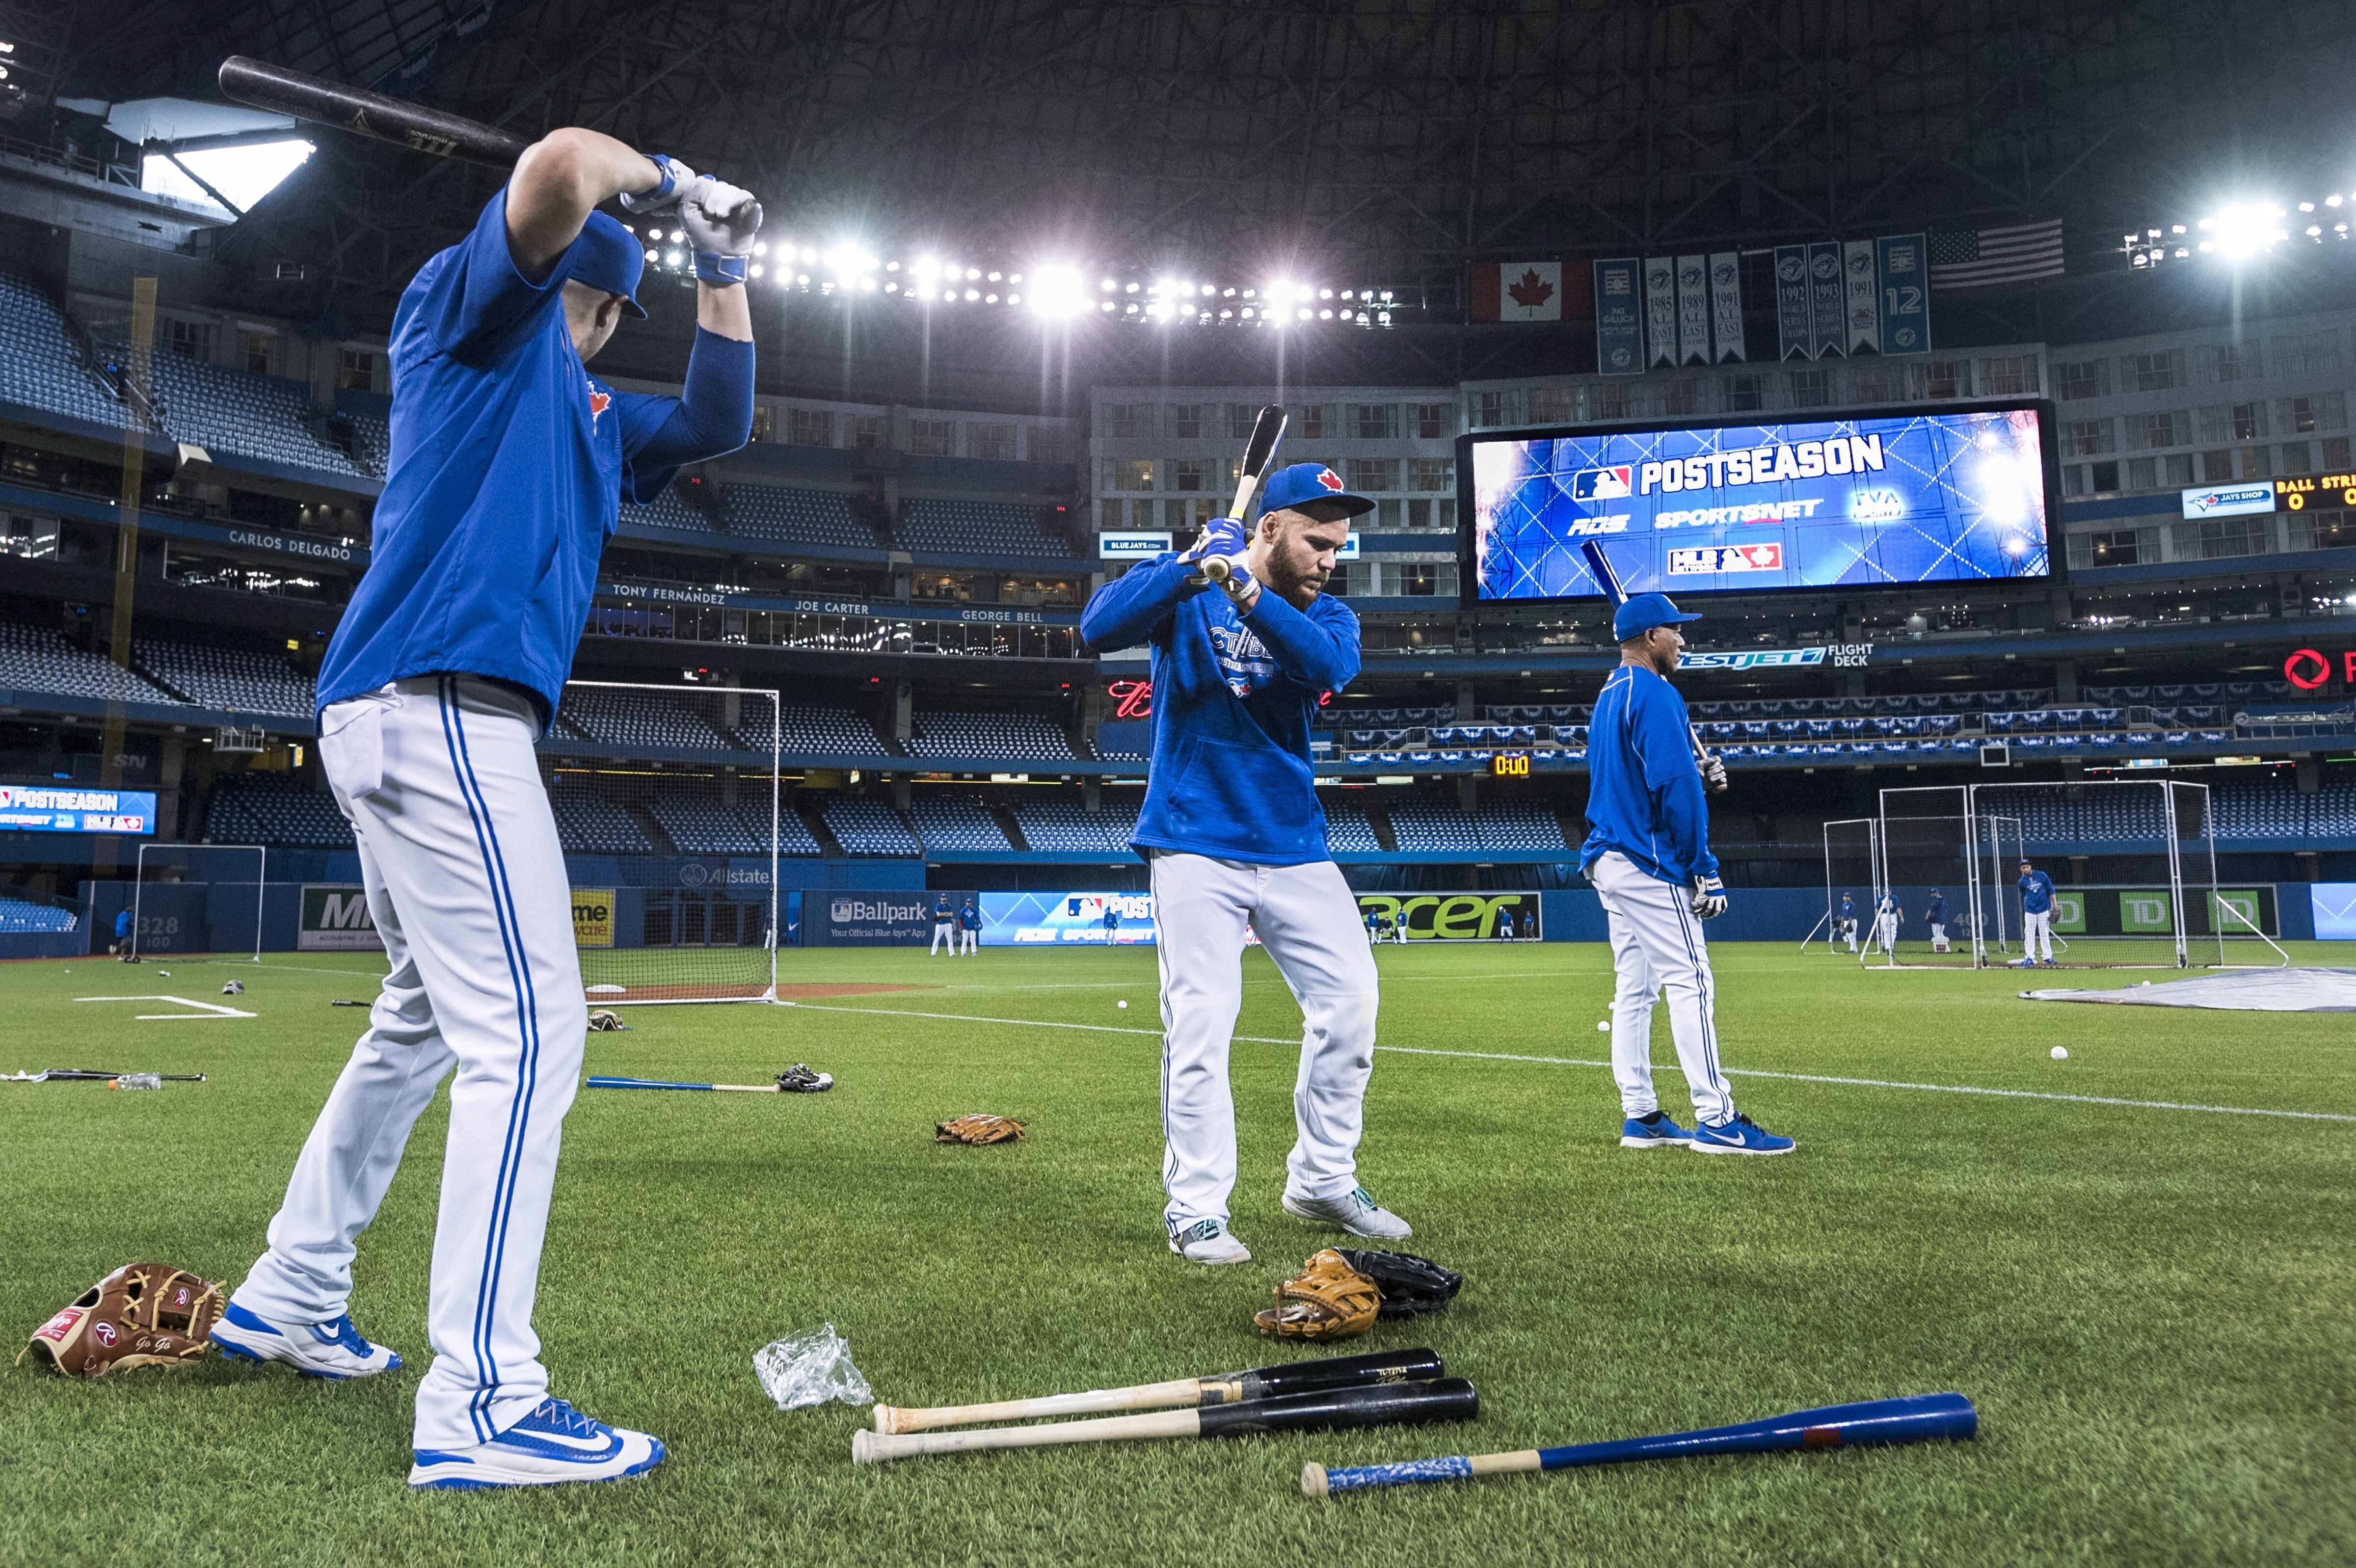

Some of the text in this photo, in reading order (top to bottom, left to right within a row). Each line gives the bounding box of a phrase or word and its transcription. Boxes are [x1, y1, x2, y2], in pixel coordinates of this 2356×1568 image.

[1781, 286, 1805, 302] 1992
[1816, 283, 1839, 300] 1993
[1850, 280, 1873, 296] 1991
[1651, 296, 1673, 312] 1985
[1682, 294, 1705, 310] 1989
[1715, 291, 1738, 307] 1991
[1886, 286, 1921, 315] 12
[1683, 324, 1706, 337] EAST
[1717, 322, 1740, 334] EAST
[1639, 433, 1885, 496] POSTSEASON
[2276, 478, 2315, 494] BALL
[2221, 491, 2263, 502] JAYS SHOP
[2288, 493, 2304, 510] 0
[1654, 499, 1820, 529] SPORTSNET
[1567, 514, 1630, 536] RDS
[229, 531, 350, 560] CARLOS DELGADO
[1672, 550, 1718, 566] MLB
[613, 585, 725, 605] TONY FERNANDEZ
[795, 600, 869, 614] JOE CARTER
[962, 610, 1043, 622] GEORGE BELL
[1828, 643, 1874, 656] FLIGHT
[1215, 656, 1252, 672] POSTSEASON
[1680, 652, 1800, 668] ESTJET
[1834, 655, 1868, 667] DECK
[112, 754, 147, 769] SN
[14, 790, 118, 812] POSTSEASON
[709, 868, 770, 884] Allstate
[853, 902, 926, 924] Ballpark
[1359, 895, 1522, 938] acer
[2125, 900, 2166, 924] TD
[849, 929, 874, 937] Official
[875, 929, 891, 937] Blue
[911, 929, 926, 939] App
[147, 937, 170, 948] 100
[136, 1336, 171, 1353] Go Go
